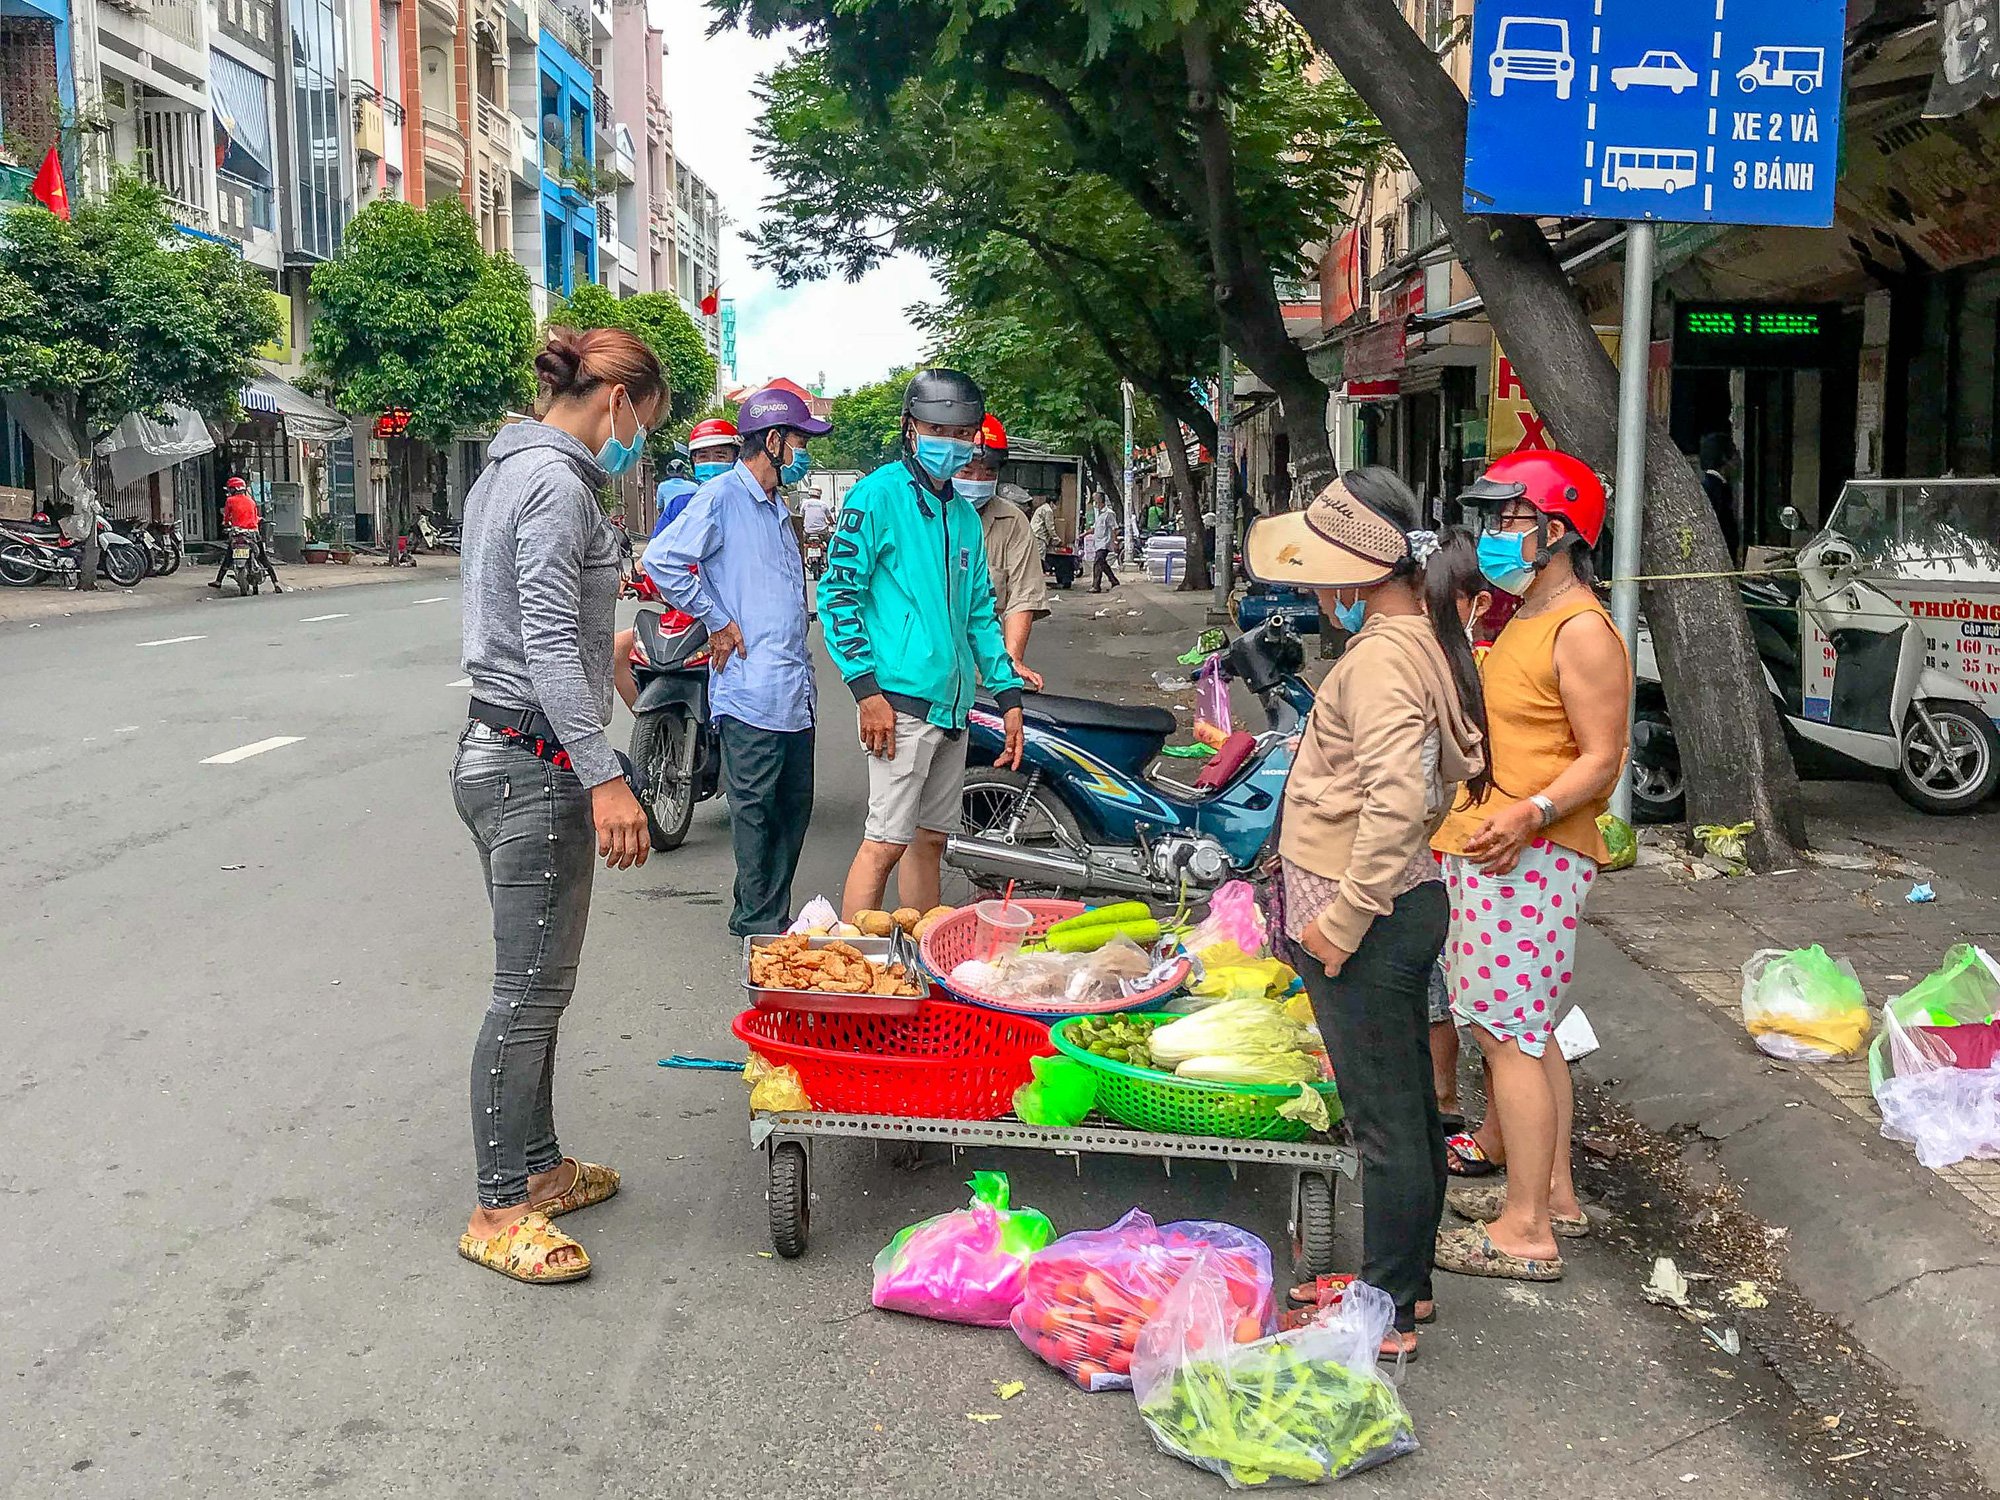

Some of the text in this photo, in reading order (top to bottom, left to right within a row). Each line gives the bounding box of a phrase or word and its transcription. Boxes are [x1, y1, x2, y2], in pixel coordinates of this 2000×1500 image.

[1731, 107, 1819, 143] XE 2 VÀ
[1732, 155, 1815, 191] 3 BÁNH
[762, 403, 789, 413] PIAGGIO
[826, 507, 871, 662] BAEMIN
[1909, 598, 2000, 621] THƯỞNG
[1956, 638, 1982, 654] 160
[1962, 657, 1981, 674] 35
